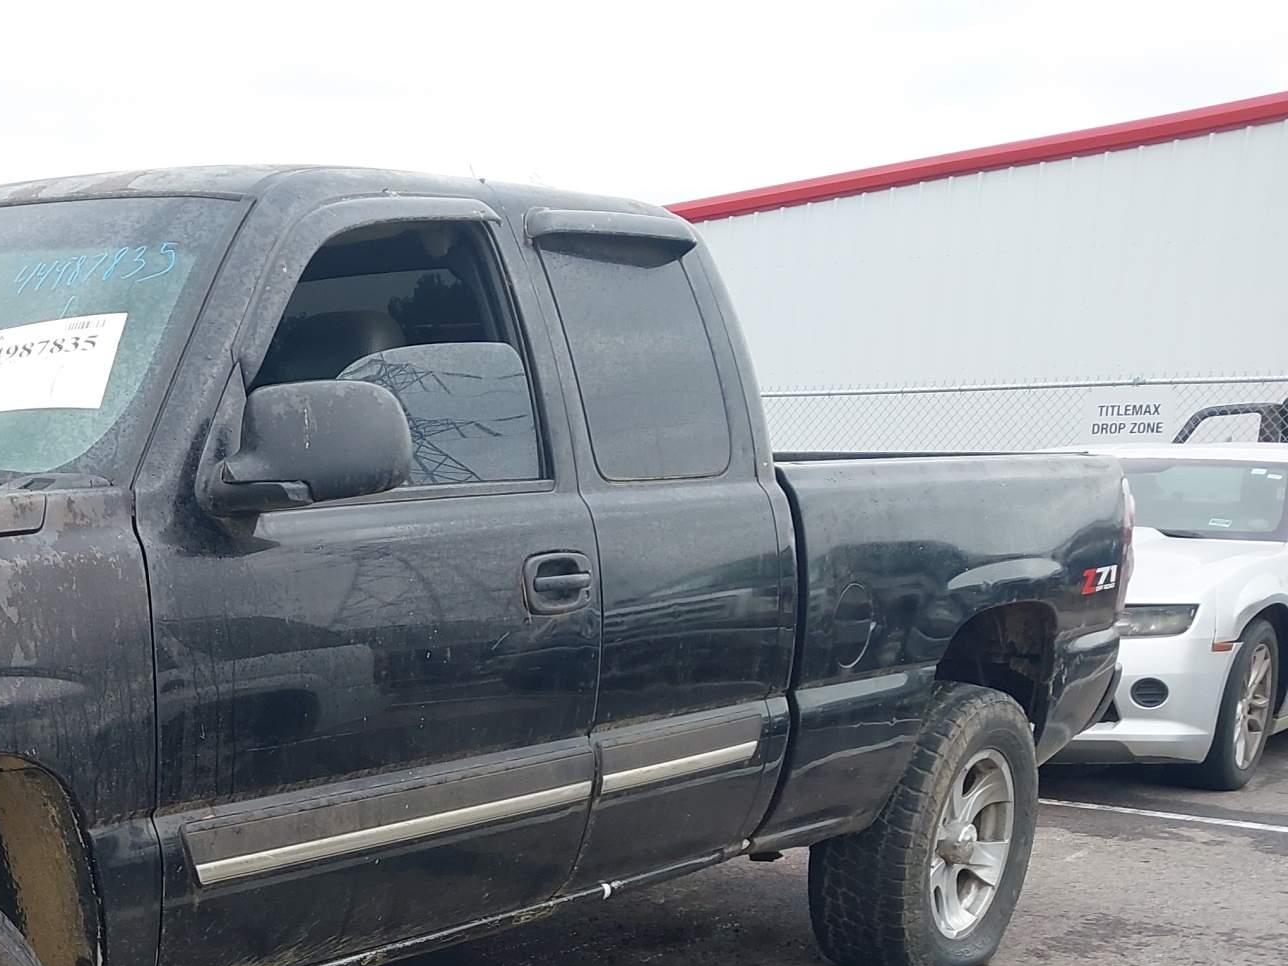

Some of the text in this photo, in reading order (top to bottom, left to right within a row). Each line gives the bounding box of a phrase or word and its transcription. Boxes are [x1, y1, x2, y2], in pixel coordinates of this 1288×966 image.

[1097, 403, 1162, 417] TITLEMAX
[1091, 421, 1164, 435] DROP ZONE
[1081, 564, 1119, 596] Z71
